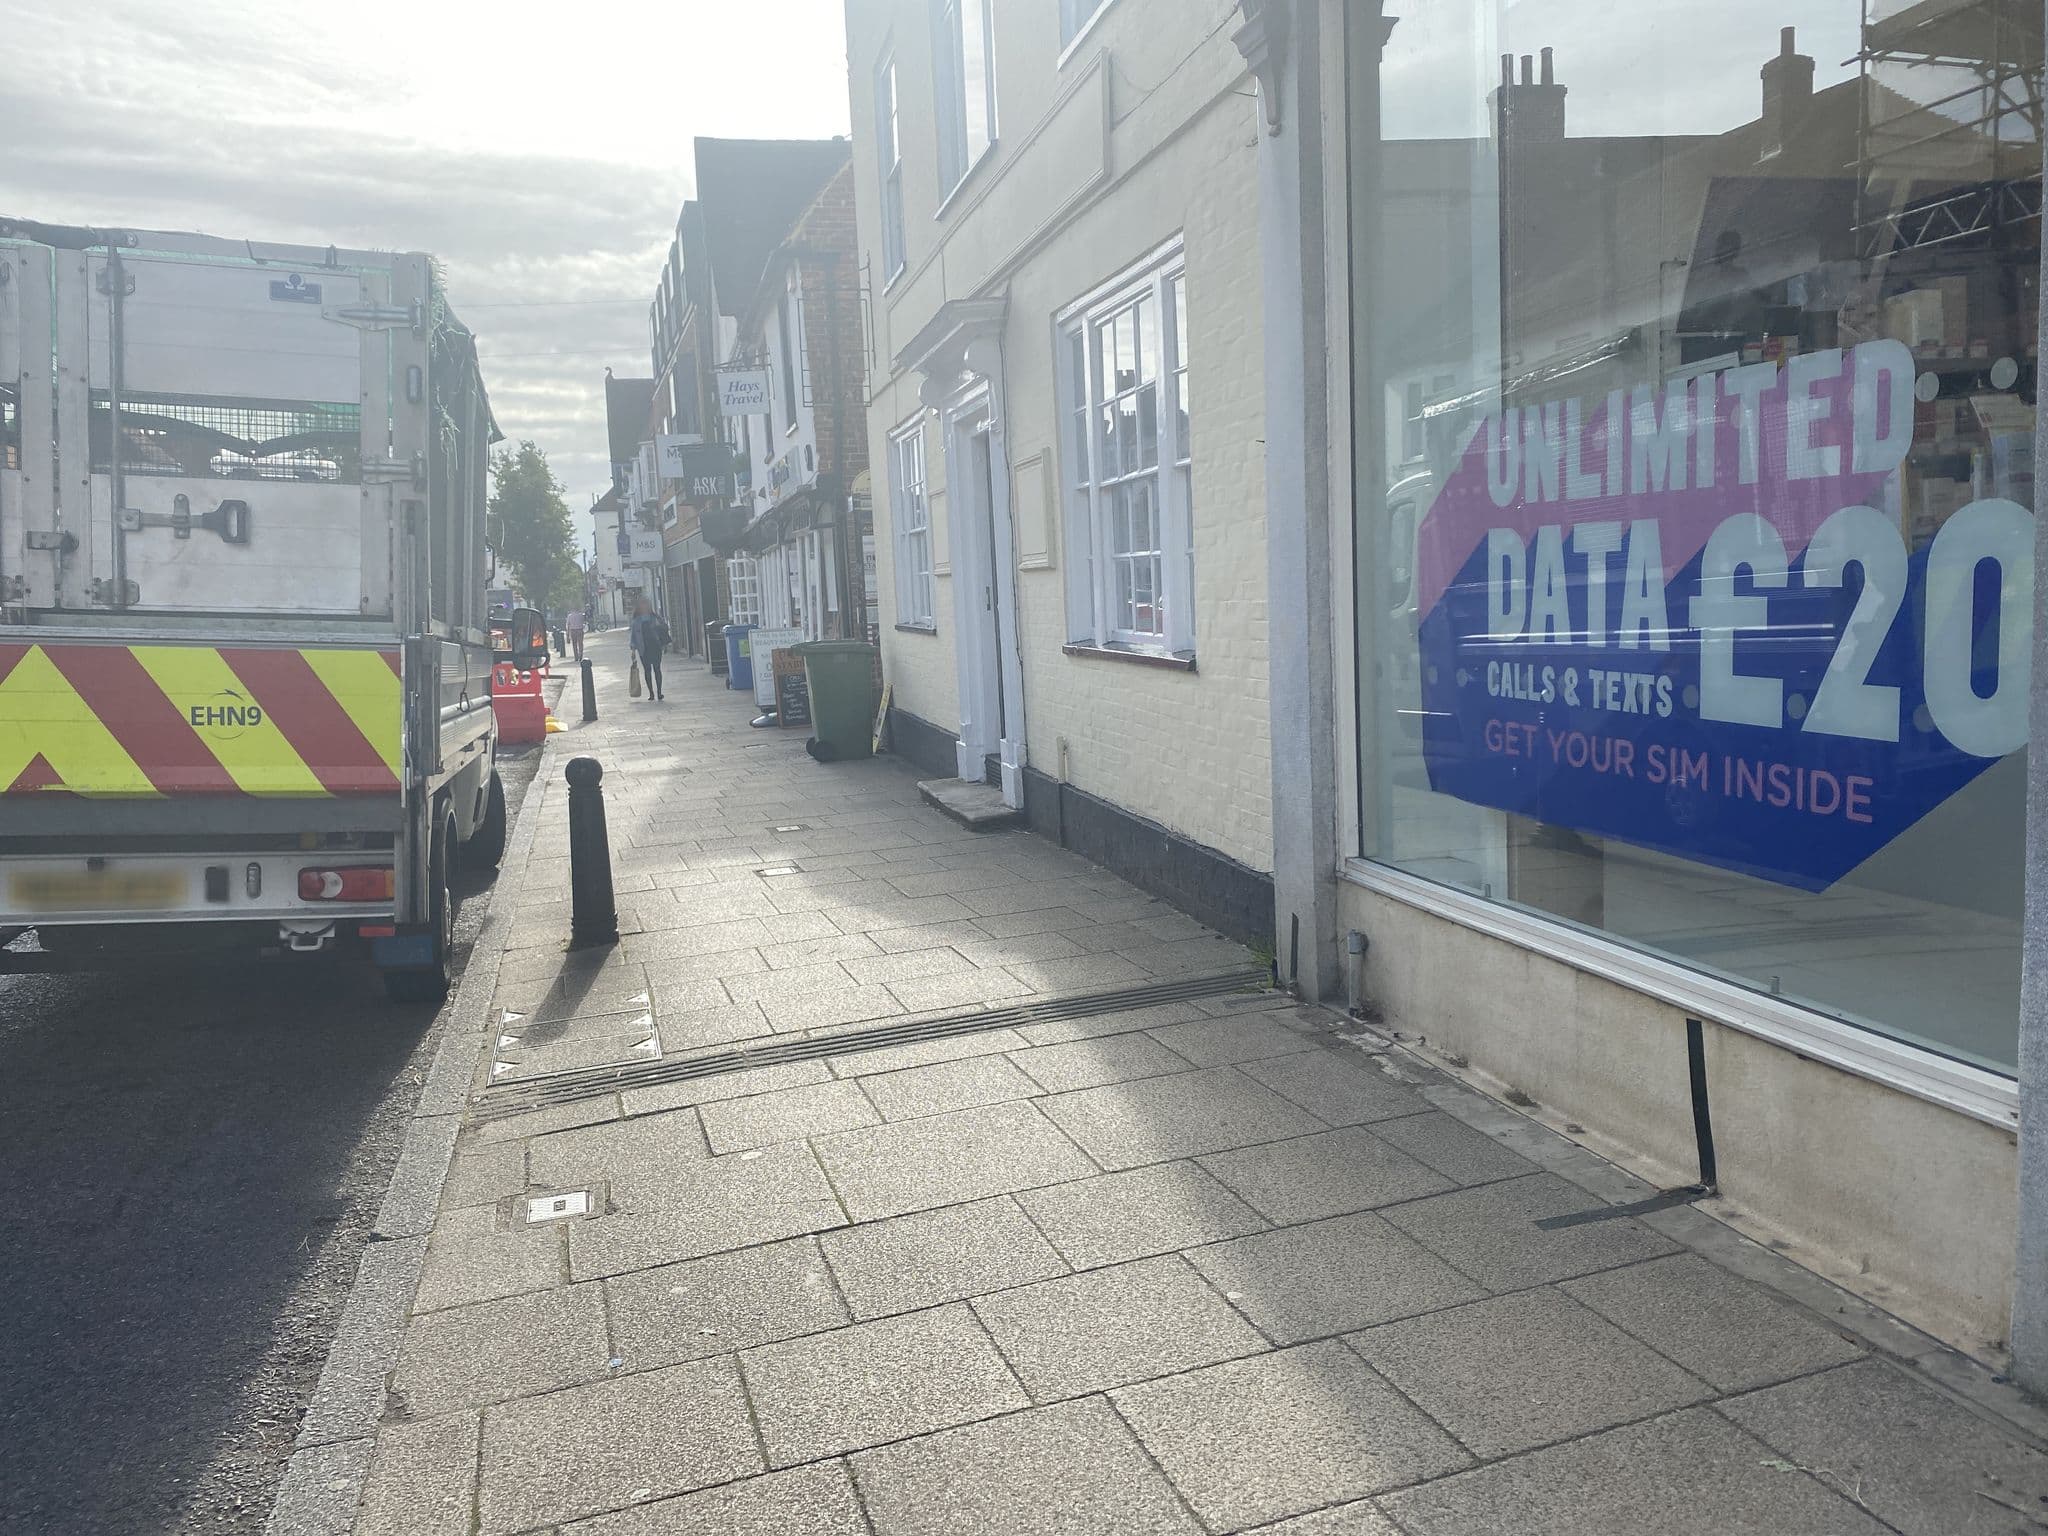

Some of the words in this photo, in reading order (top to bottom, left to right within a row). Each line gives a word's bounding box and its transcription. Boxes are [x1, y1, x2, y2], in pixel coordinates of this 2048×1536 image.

[724, 392, 764, 405] Travel
[728, 381, 760, 393] Hays
[1487, 339, 1915, 508] UNLIMITED
[693, 477, 718, 495] ASK
[636, 540, 656, 550] M&S
[1487, 518, 1671, 652] DATA
[1688, 498, 2036, 757] £20
[1487, 660, 1555, 703] CALLS
[1564, 667, 1580, 706] &
[1589, 669, 1673, 718] TEXTS
[191, 706, 262, 727] EHN9
[1485, 720, 1538, 758] GET
[1547, 728, 1634, 778] YOUR
[1647, 744, 1708, 791] SIM
[1724, 756, 1873, 823] INSIDE
